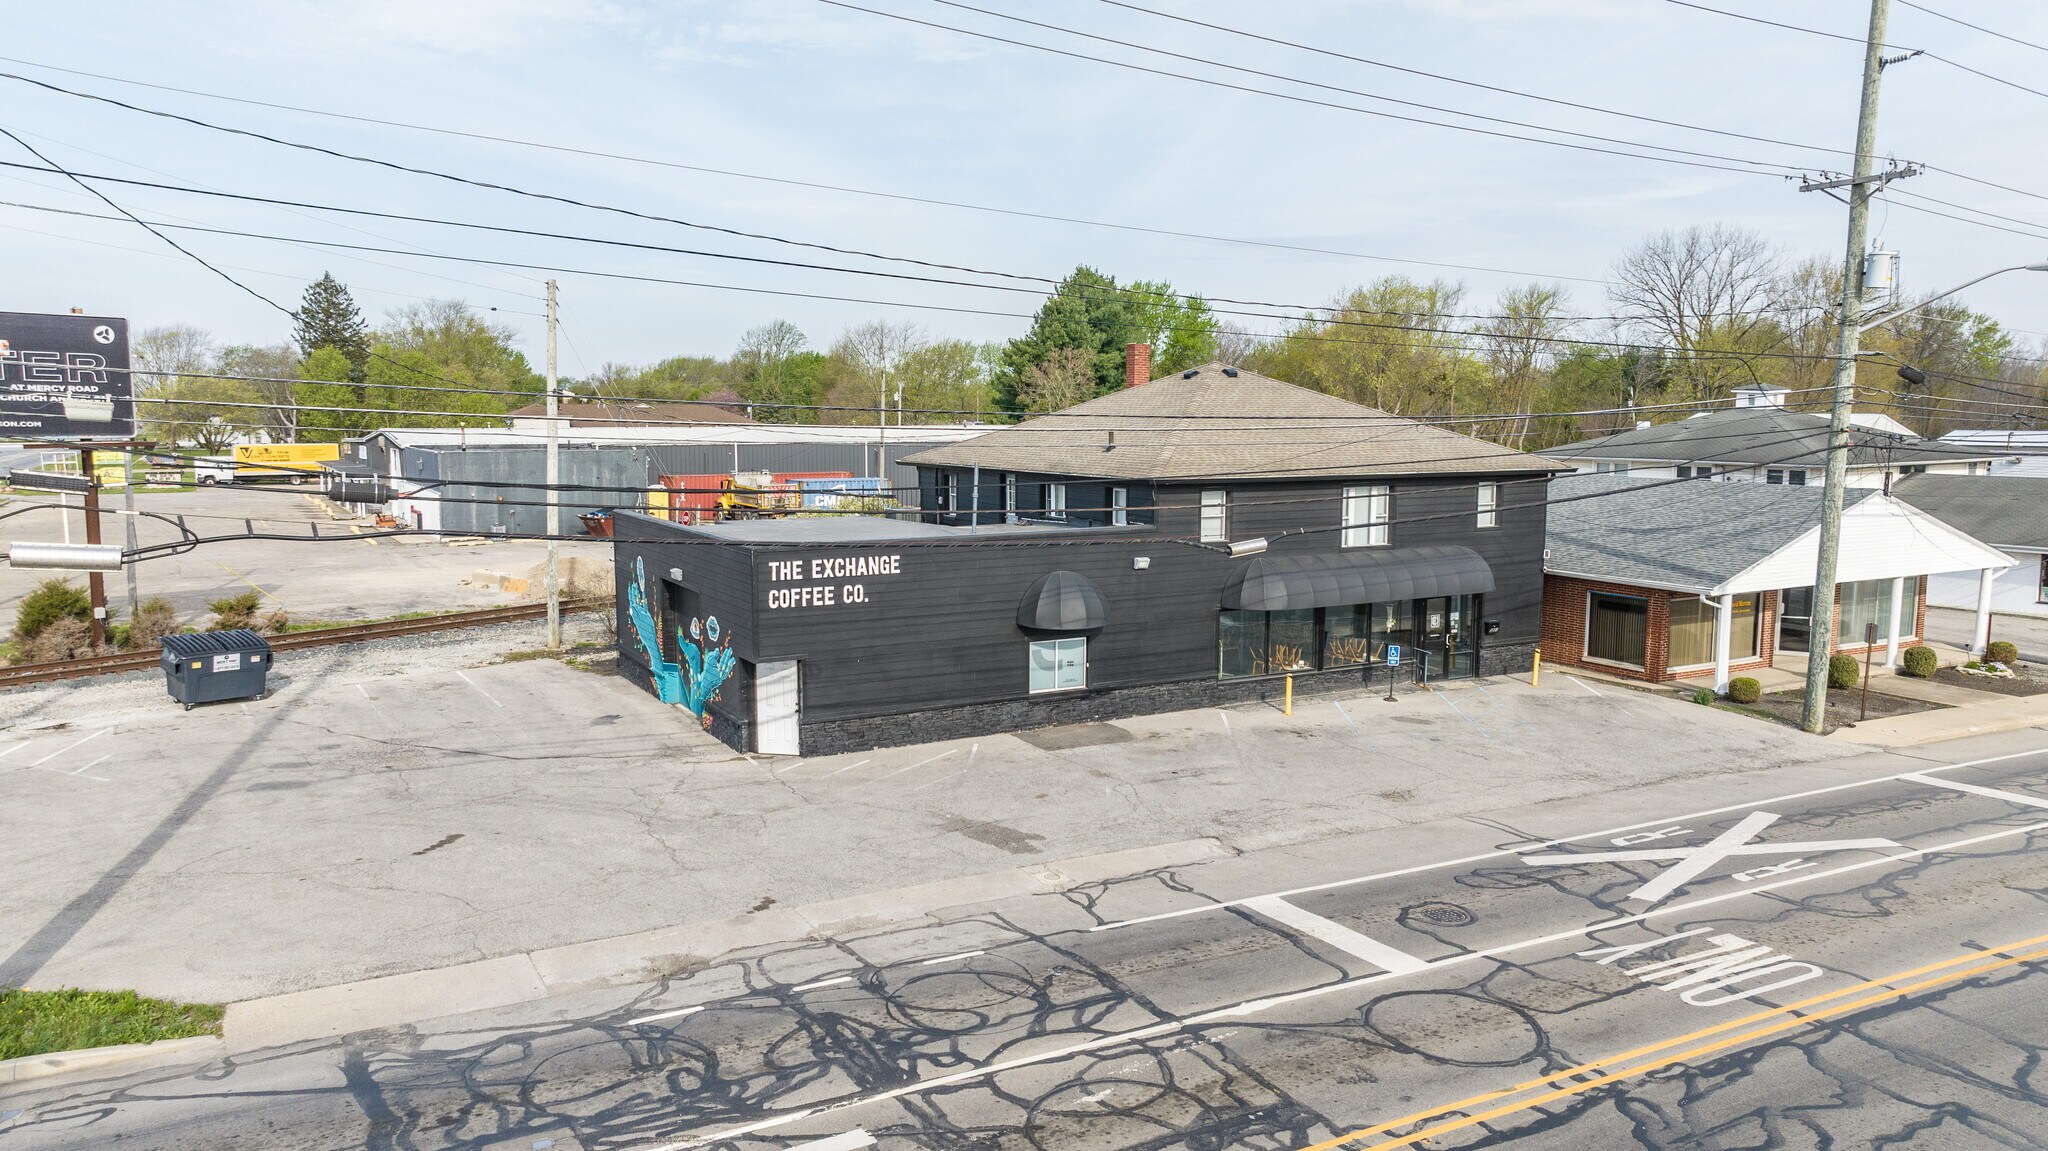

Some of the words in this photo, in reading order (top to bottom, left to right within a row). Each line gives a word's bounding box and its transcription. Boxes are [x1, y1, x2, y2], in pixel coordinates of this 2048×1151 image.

[0, 394, 47, 402] CHURCH
[27, 384, 65, 392] MERCY
[769, 560, 803, 581] THE
[811, 555, 900, 578] EXCHANGE
[768, 586, 835, 609] COFFEE
[843, 584, 869, 604] CO.
[1575, 926, 1824, 1007] ONLY
